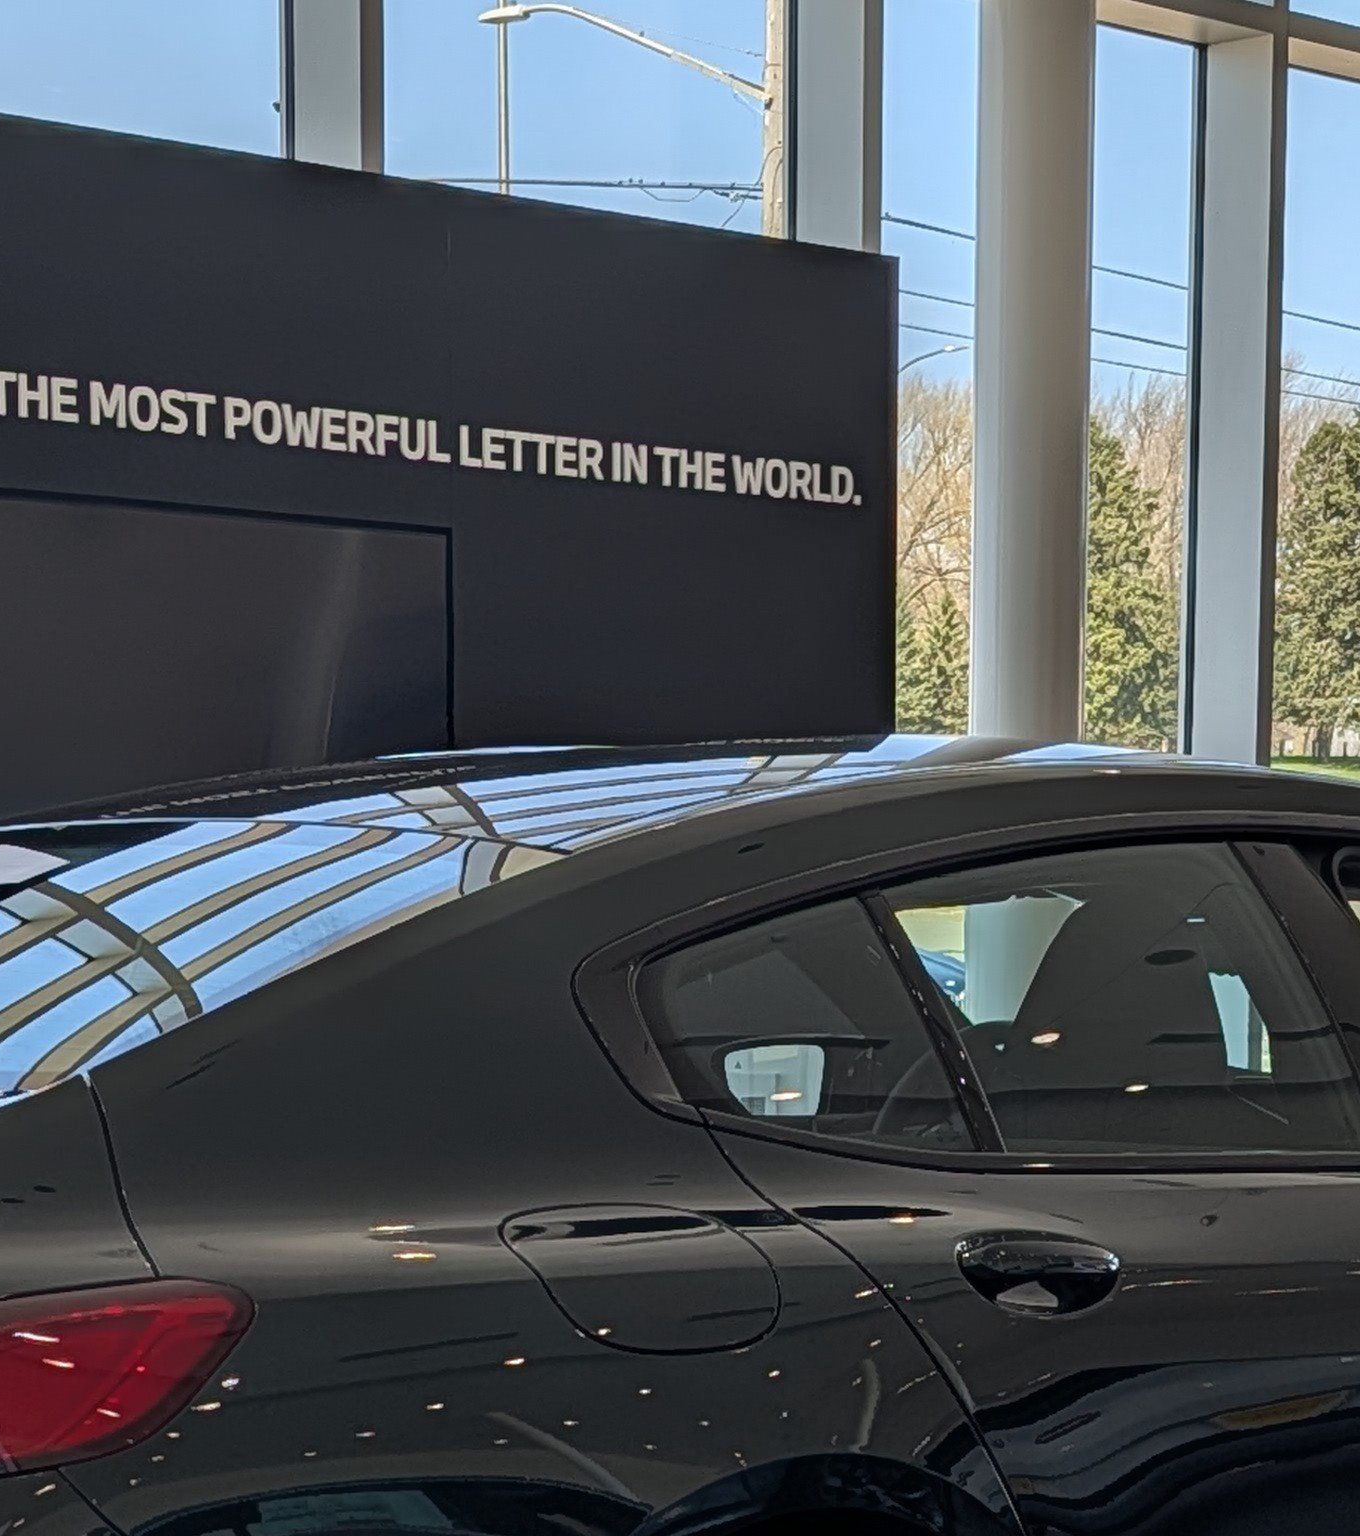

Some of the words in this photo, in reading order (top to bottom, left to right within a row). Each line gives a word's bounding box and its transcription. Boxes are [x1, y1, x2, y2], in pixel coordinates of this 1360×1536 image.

[89, 380, 217, 438] MOST
[224, 396, 452, 464] POWERFUL
[459, 424, 605, 481] LETTER
[610, 441, 649, 485] IN
[652, 446, 727, 493] THE
[731, 454, 863, 506] WORLD.
